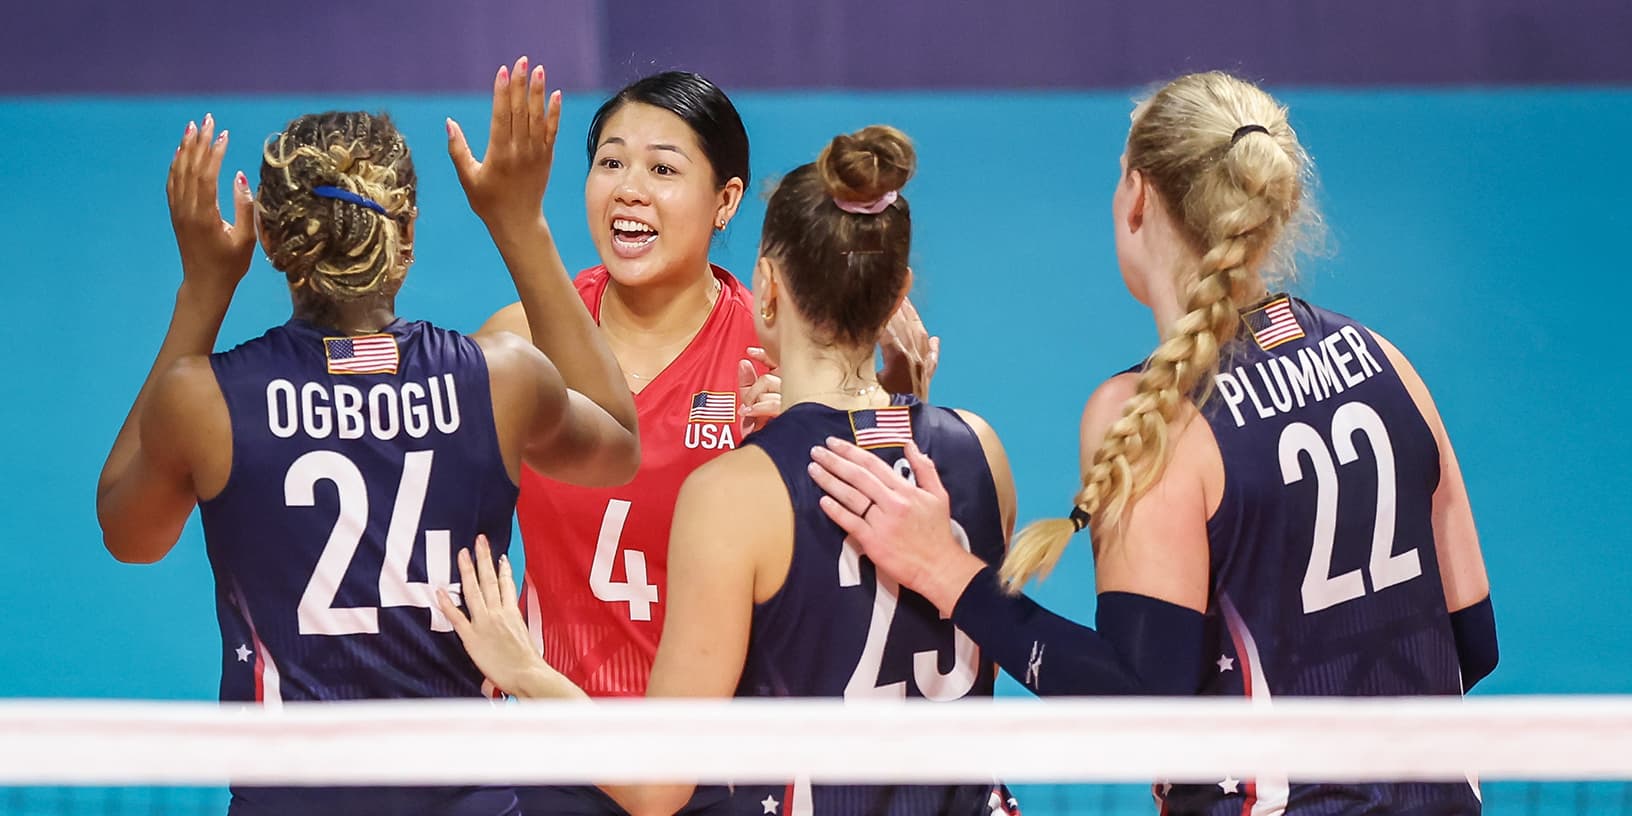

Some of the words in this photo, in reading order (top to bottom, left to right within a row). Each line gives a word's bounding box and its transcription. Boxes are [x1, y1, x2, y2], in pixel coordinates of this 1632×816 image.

[266, 374, 460, 441] OGBOGU
[1216, 324, 1382, 428] PLUMMER
[684, 423, 735, 449] USA
[283, 449, 461, 636] 24
[589, 499, 658, 621] 4
[1278, 401, 1421, 614] 22
